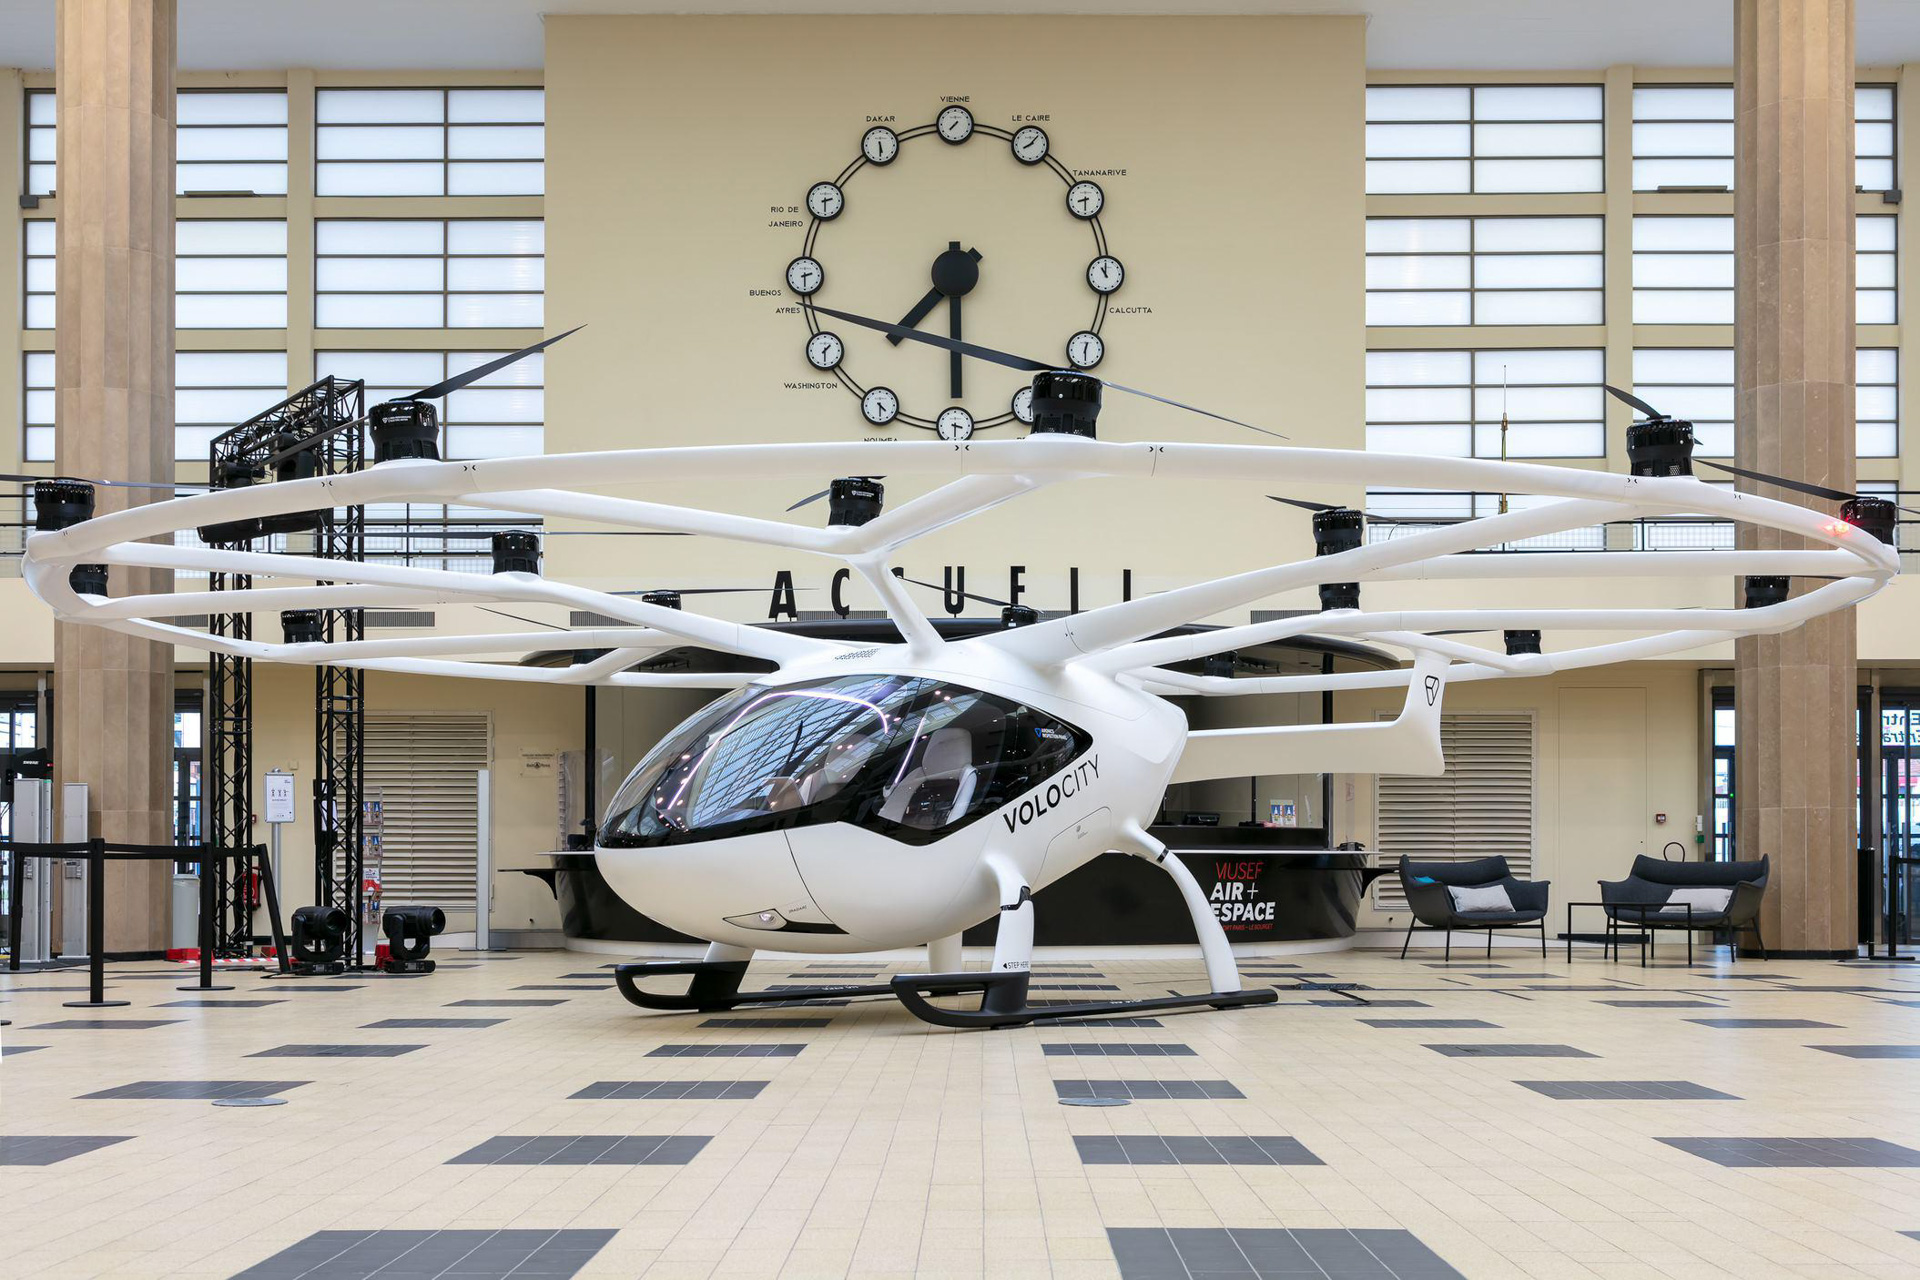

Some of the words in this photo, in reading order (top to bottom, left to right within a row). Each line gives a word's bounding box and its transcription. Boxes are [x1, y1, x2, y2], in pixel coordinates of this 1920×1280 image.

[1109, 306, 1153, 314] CALCUTTA
[783, 381, 838, 389] WASHINGTON
[768, 565, 1132, 618] ACUEI
[1003, 753, 1099, 834] VOLOCITY
[1210, 882, 1244, 901] AIR
[1210, 902, 1276, 922] ESPACE
[1007, 961, 1020, 970] STEP
